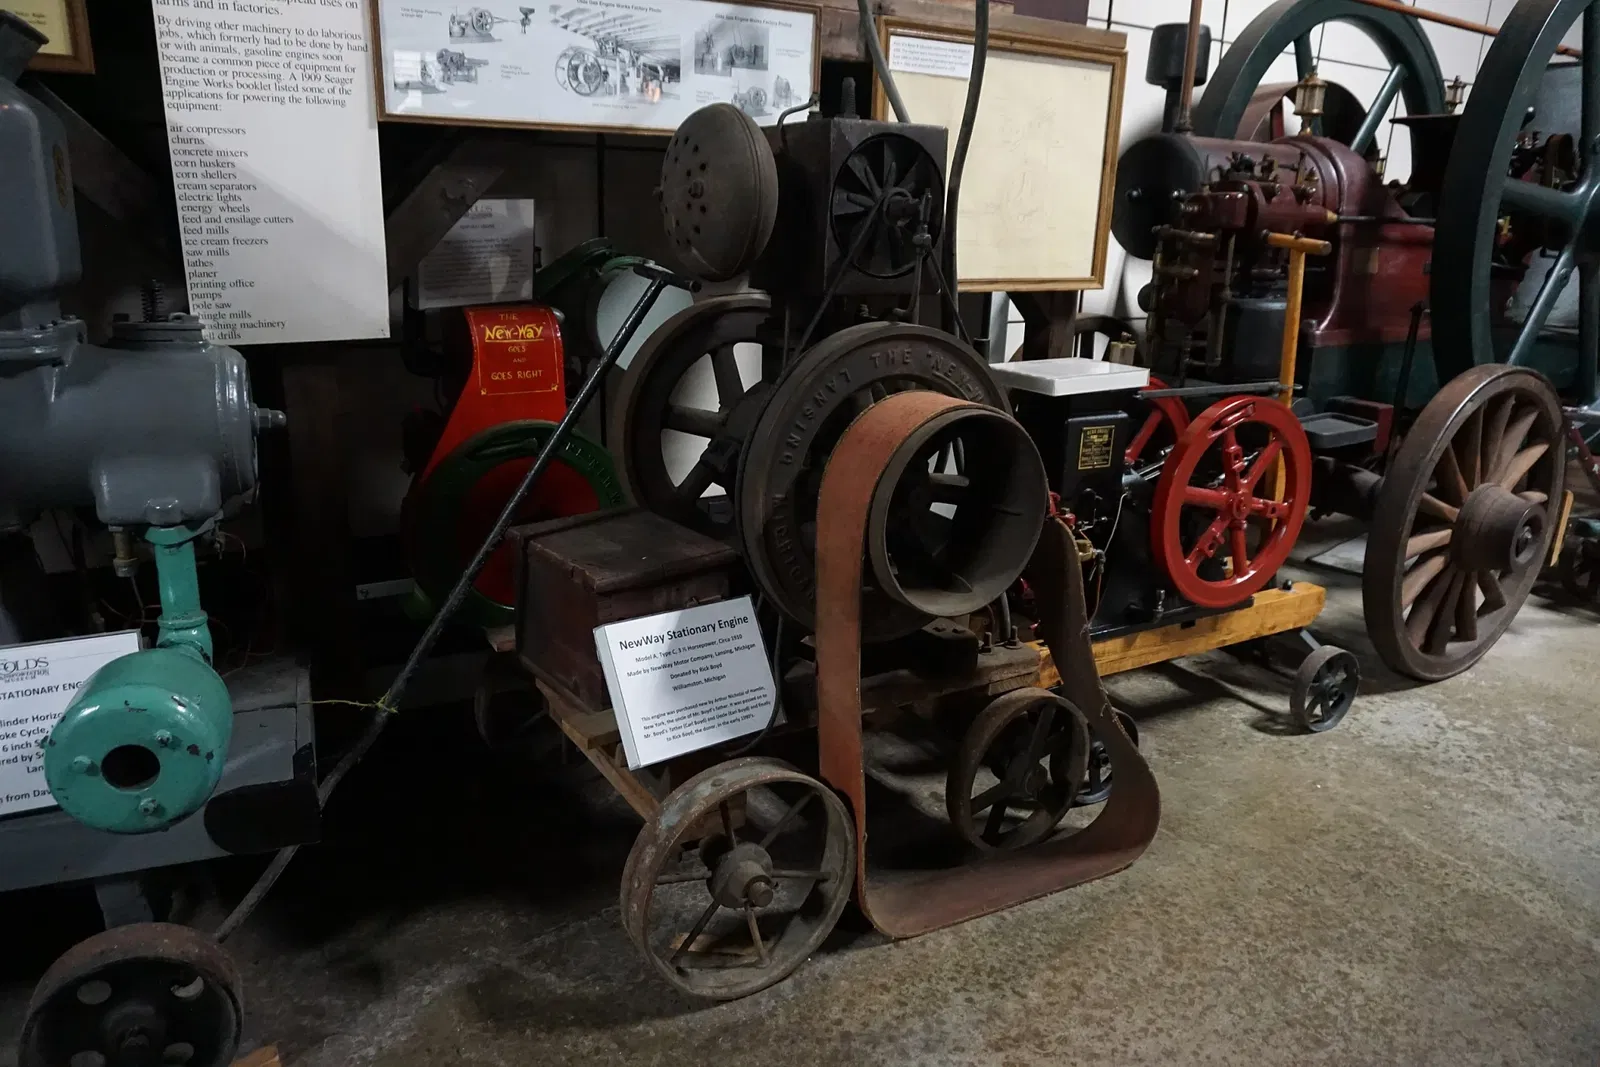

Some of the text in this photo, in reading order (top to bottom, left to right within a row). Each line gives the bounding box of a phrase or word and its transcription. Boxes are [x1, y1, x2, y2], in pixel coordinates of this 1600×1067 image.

[193, 0, 214, 9] and
[218, 0, 229, 11] in
[233, 1, 283, 16] factories.
[345, 0, 358, 9] on
[157, 15, 362, 40] By driving other machinery to do laborious
[159, 28, 368, 52] jobs, which formerly had to be done by hand
[160, 41, 343, 62] or with animals, gasoline engines soon
[161, 52, 200, 63] became
[211, 57, 253, 67] common
[256, 59, 280, 69] piece
[283, 61, 292, 69] of
[294, 62, 342, 73] equipment
[344, 64, 356, 73] for
[163, 65, 216, 76] production
[232, 70, 285, 82] processing.
[289, 72, 297, 81] A
[301, 72, 322, 82] 1909
[324, 74, 353, 86] Seager
[165, 76, 352, 95] Engine Works booklet listed some of the
[166, 89, 347, 108] applications for powering the following
[167, 101, 222, 112] equipment:
[169, 123, 247, 136] air compressors
[171, 134, 205, 145] churns
[172, 148, 249, 157] concrete mixers
[174, 159, 236, 168] corn huskers
[175, 169, 237, 180] corn shellers
[177, 183, 257, 193] cream separators
[178, 192, 242, 204] electric lights
[181, 204, 251, 214] energy wheels
[182, 214, 294, 226] feed and ensilage cutters
[183, 225, 230, 235] feed mills
[184, 236, 269, 246] ice cream freezers
[185, 247, 230, 257] saw mills
[187, 259, 214, 268] lathes
[188, 270, 218, 280] planer
[189, 279, 255, 291] printing office
[191, 292, 222, 301] pumps
[192, 301, 212, 311] pole
[229, 310, 252, 320] mills
[240, 319, 286, 330] machinery
[217, 331, 242, 340] drills
[508, 345, 526, 353] GOES
[869, 347, 912, 369] THE
[491, 369, 543, 380] GOES RIGHT
[619, 616, 749, 650] NewWay Stationary Engine
[635, 654, 652, 663] Model
[687, 640, 718, 651] Horsepower,
[650, 663, 673, 672] NewWay
[673, 658, 690, 666] Motor
[690, 654, 714, 663] Company,
[715, 649, 734, 657] Lansing,
[734, 643, 756, 652] Michigan
[670, 669, 691, 679] Donated
[709, 662, 723, 670] Boyd
[672, 674, 727, 691] Williamston, Michigan
[20, 726, 49, 738] Cycle,
[11, 741, 32, 751] inch
[21, 754, 33, 763] by
[6, 792, 30, 803] from
